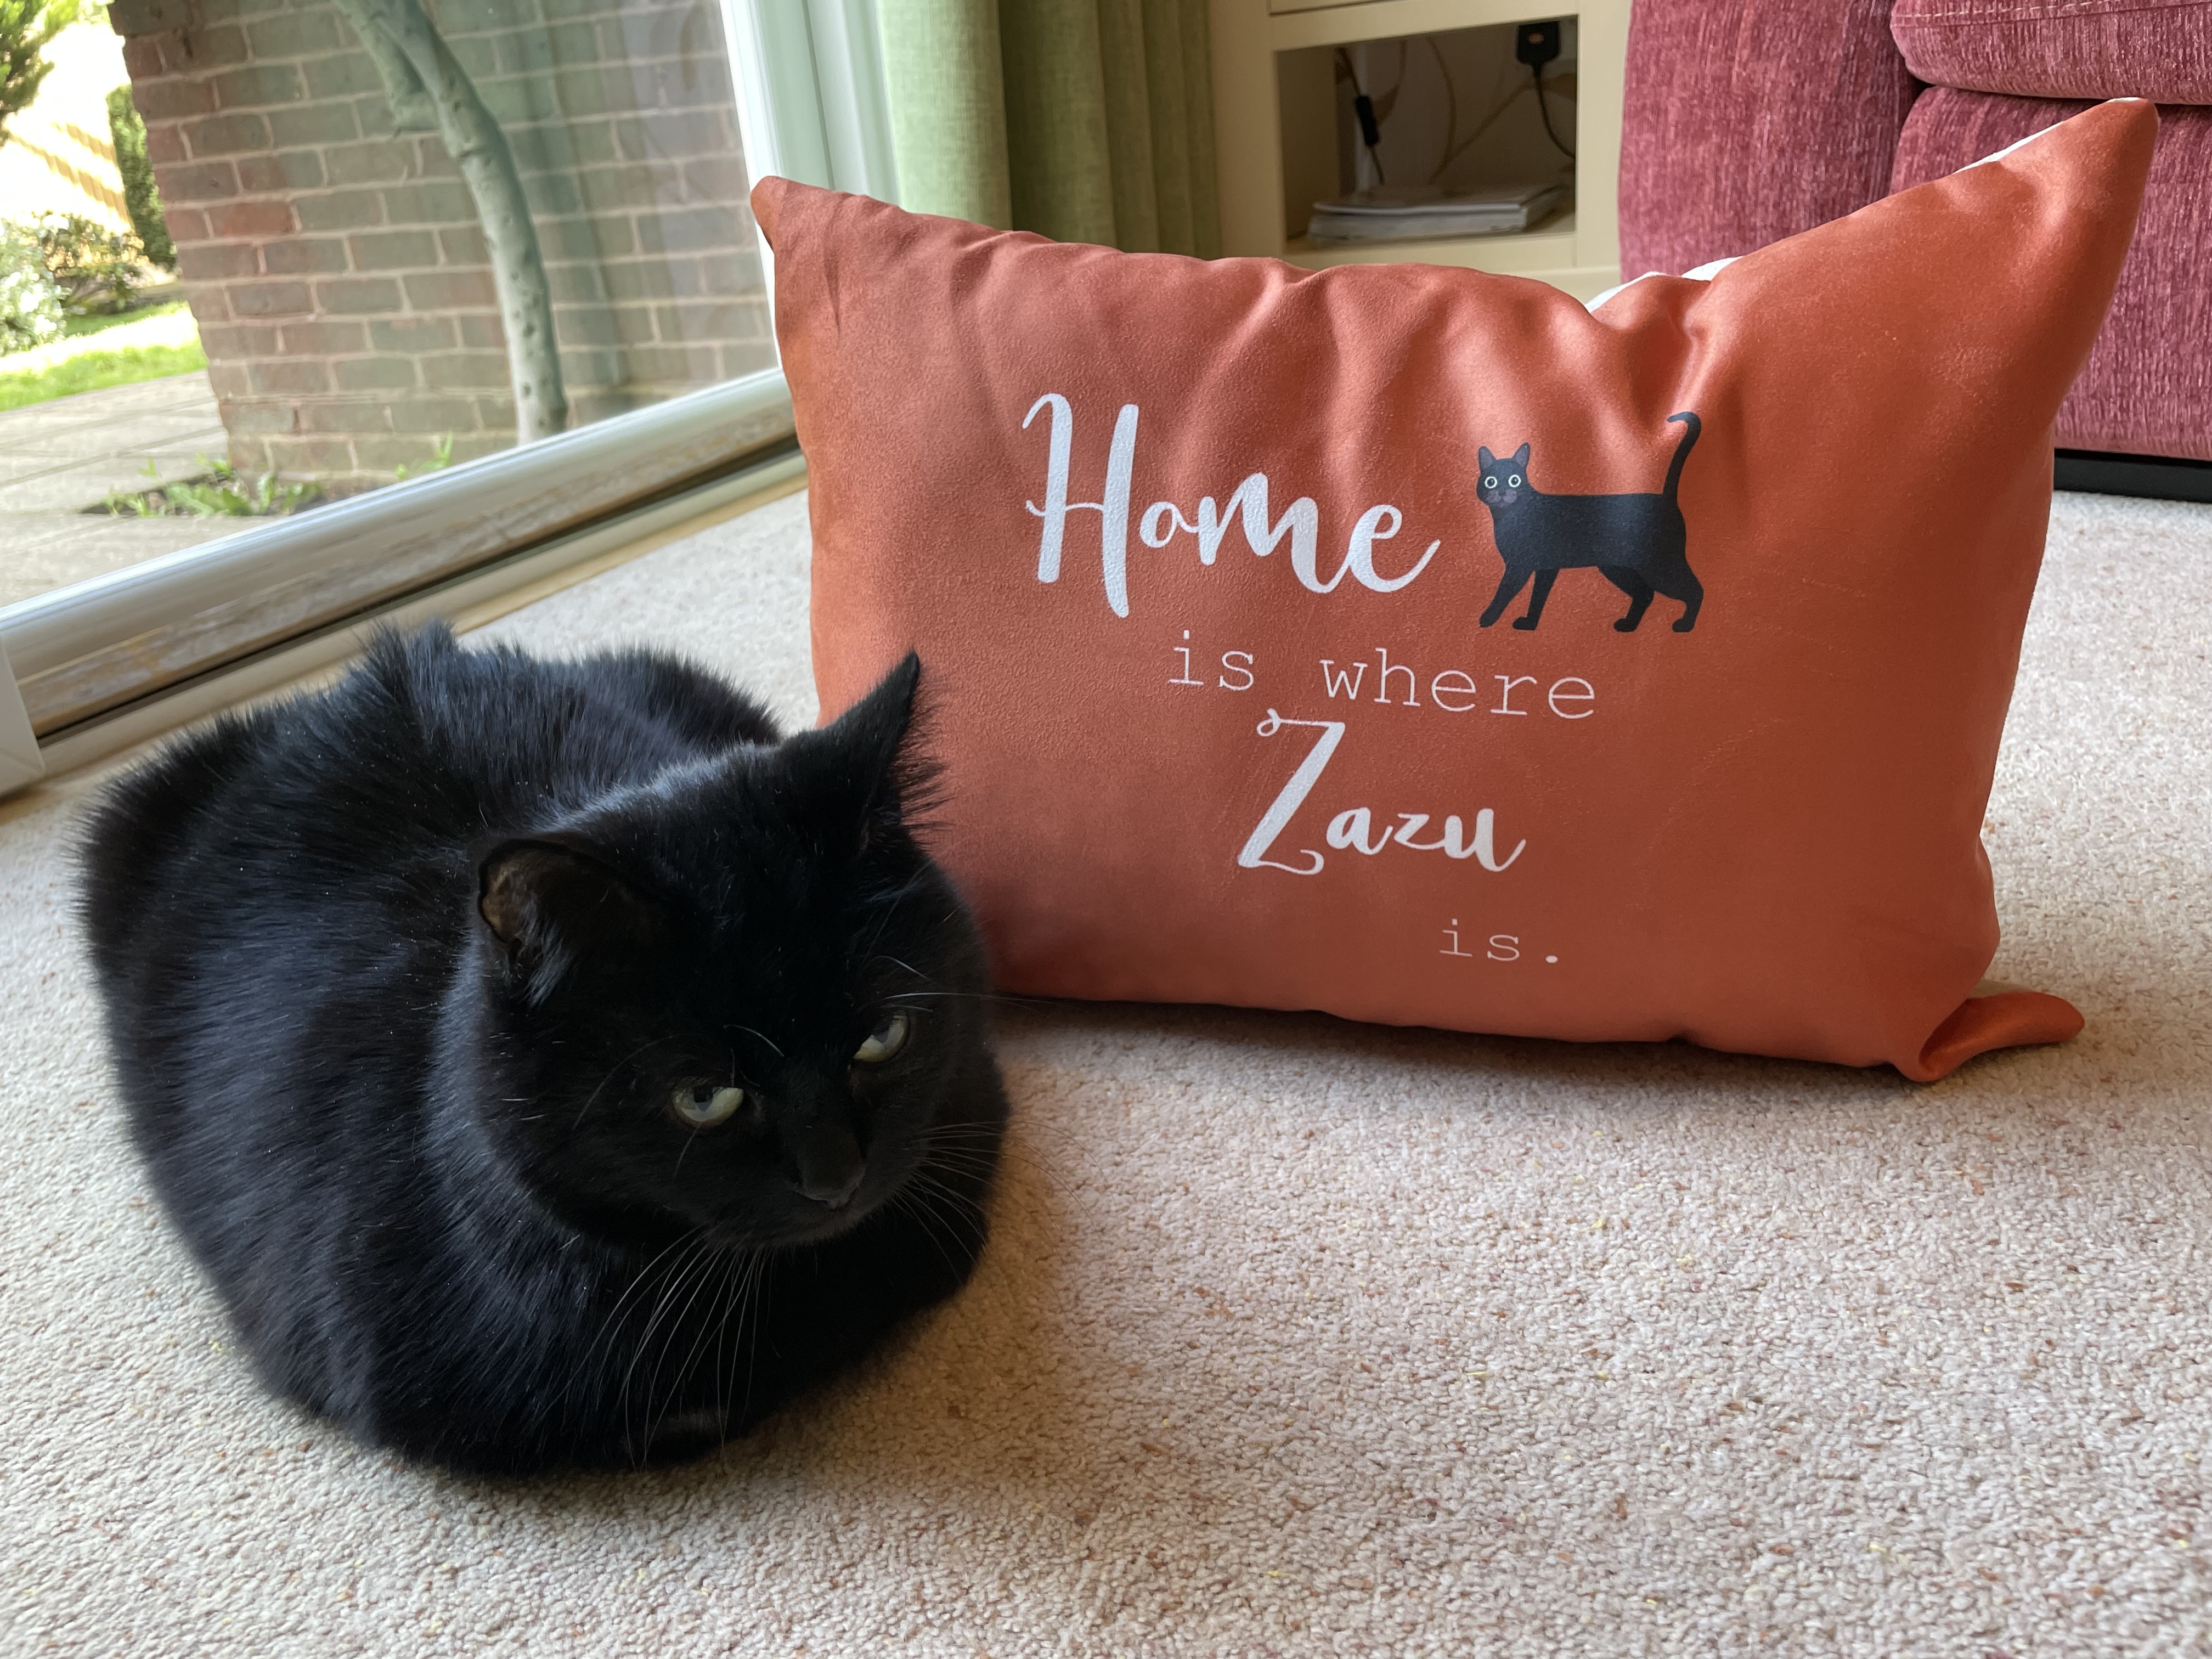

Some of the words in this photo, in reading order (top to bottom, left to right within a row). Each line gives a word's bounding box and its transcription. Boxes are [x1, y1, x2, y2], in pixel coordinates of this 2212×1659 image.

[1022, 393, 1441, 618] Home
[1168, 629, 1255, 691] is
[1319, 648, 1596, 719] where
[1237, 708, 1526, 874] Zazu
[1438, 918, 1559, 963] is.
